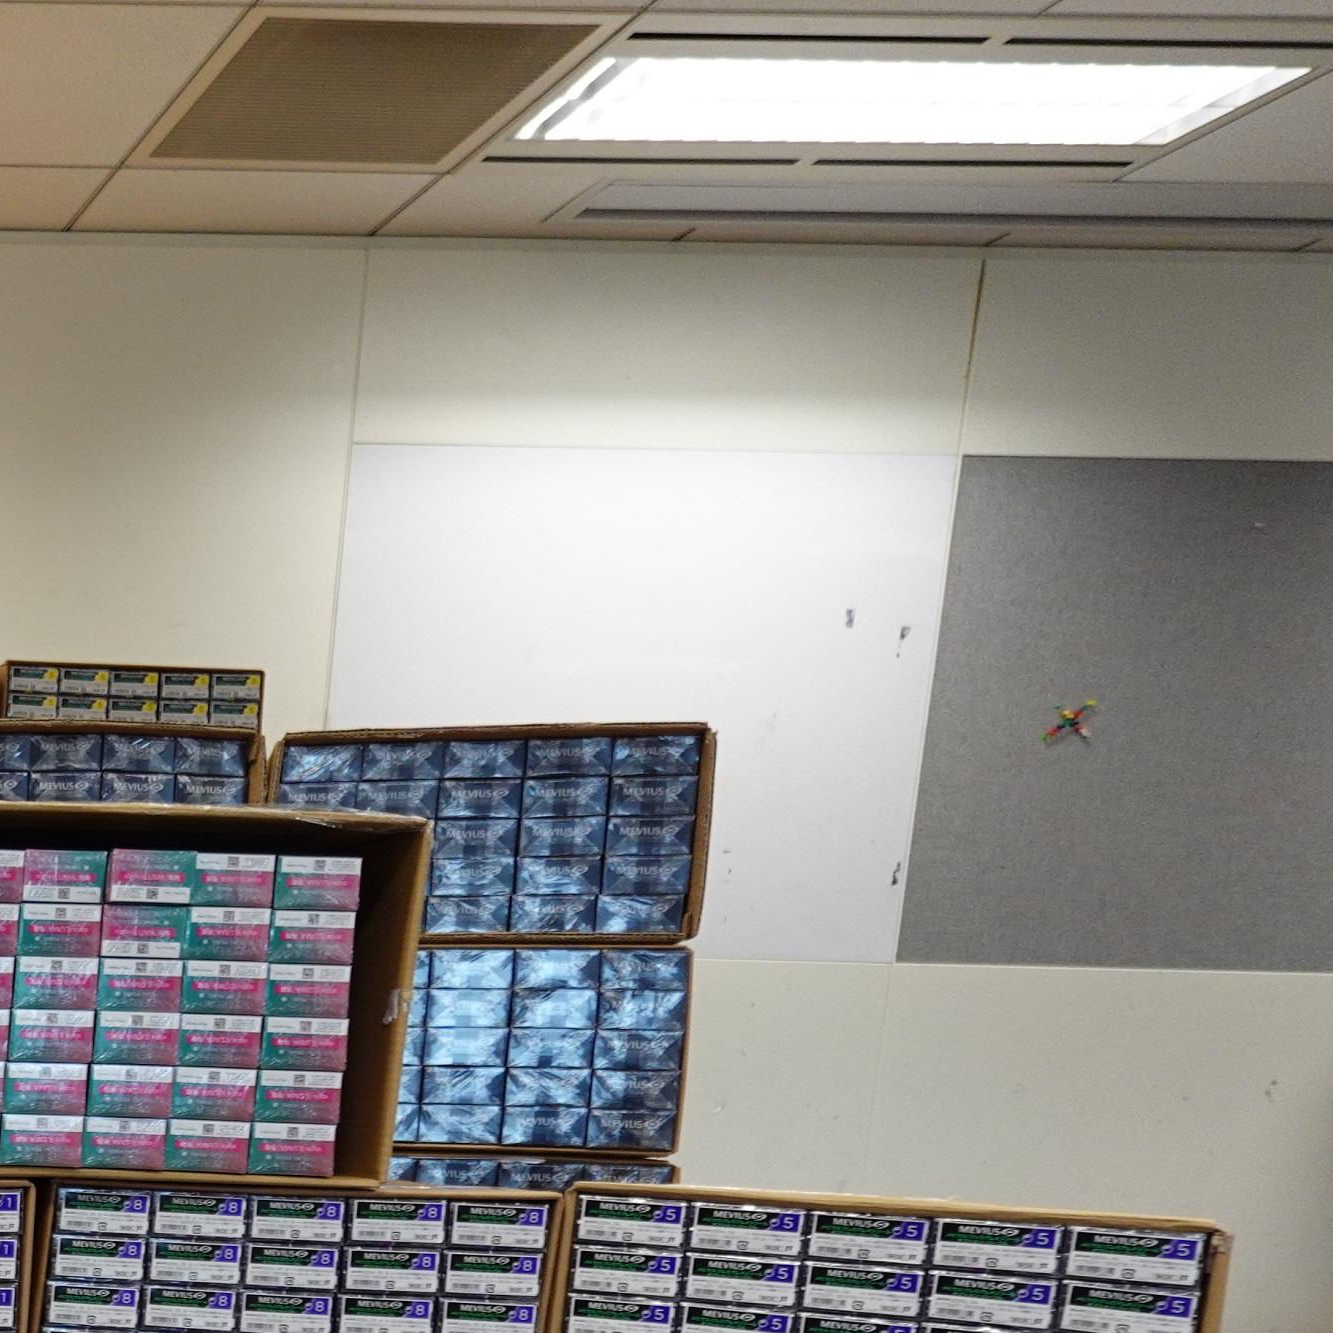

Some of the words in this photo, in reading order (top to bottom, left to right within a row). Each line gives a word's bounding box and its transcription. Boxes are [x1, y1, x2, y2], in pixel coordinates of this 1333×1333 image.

[39, 781, 74, 792] MEVIUS
[113, 782, 148, 793] MEVIUS
[186, 784, 222, 795] MEVIUS
[451, 788, 492, 800] MEVIUS
[535, 787, 576, 799] MEVIUS
[622, 785, 664, 797] MEVIUS
[77, 1194, 109, 1204] MEVIUS
[133, 1199, 143, 1211] 8
[172, 1197, 204, 1207] MEVIUS
[228, 1202, 238, 1214] 8
[269, 1201, 301, 1211] MEVIUS
[327, 1206, 337, 1218] 8
[370, 1203, 402, 1213] MEVIUS
[428, 1207, 438, 1219] 8
[470, 1207, 502, 1217] MEVIUS
[529, 1212, 539, 1224] 8
[599, 1202, 635, 1213] MEVIUS
[666, 1209, 677, 1221] 5
[714, 1210, 750, 1221] MEVIUS
[783, 1217, 794, 1229] 5
[832, 1217, 873, 1229] MEVIUS
[905, 1225, 918, 1238] 5
[958, 1225, 1001, 1237] MEVIUS
[1036, 1233, 1049, 1246] 5
[1094, 1234, 1138, 1247] MEVIUS
[1178, 1244, 1191, 1257] 5
[588, 1302, 624, 1313] MEVIUS
[654, 1309, 665, 1321] 5
[820, 1319, 860, 1331] MEVIUS
